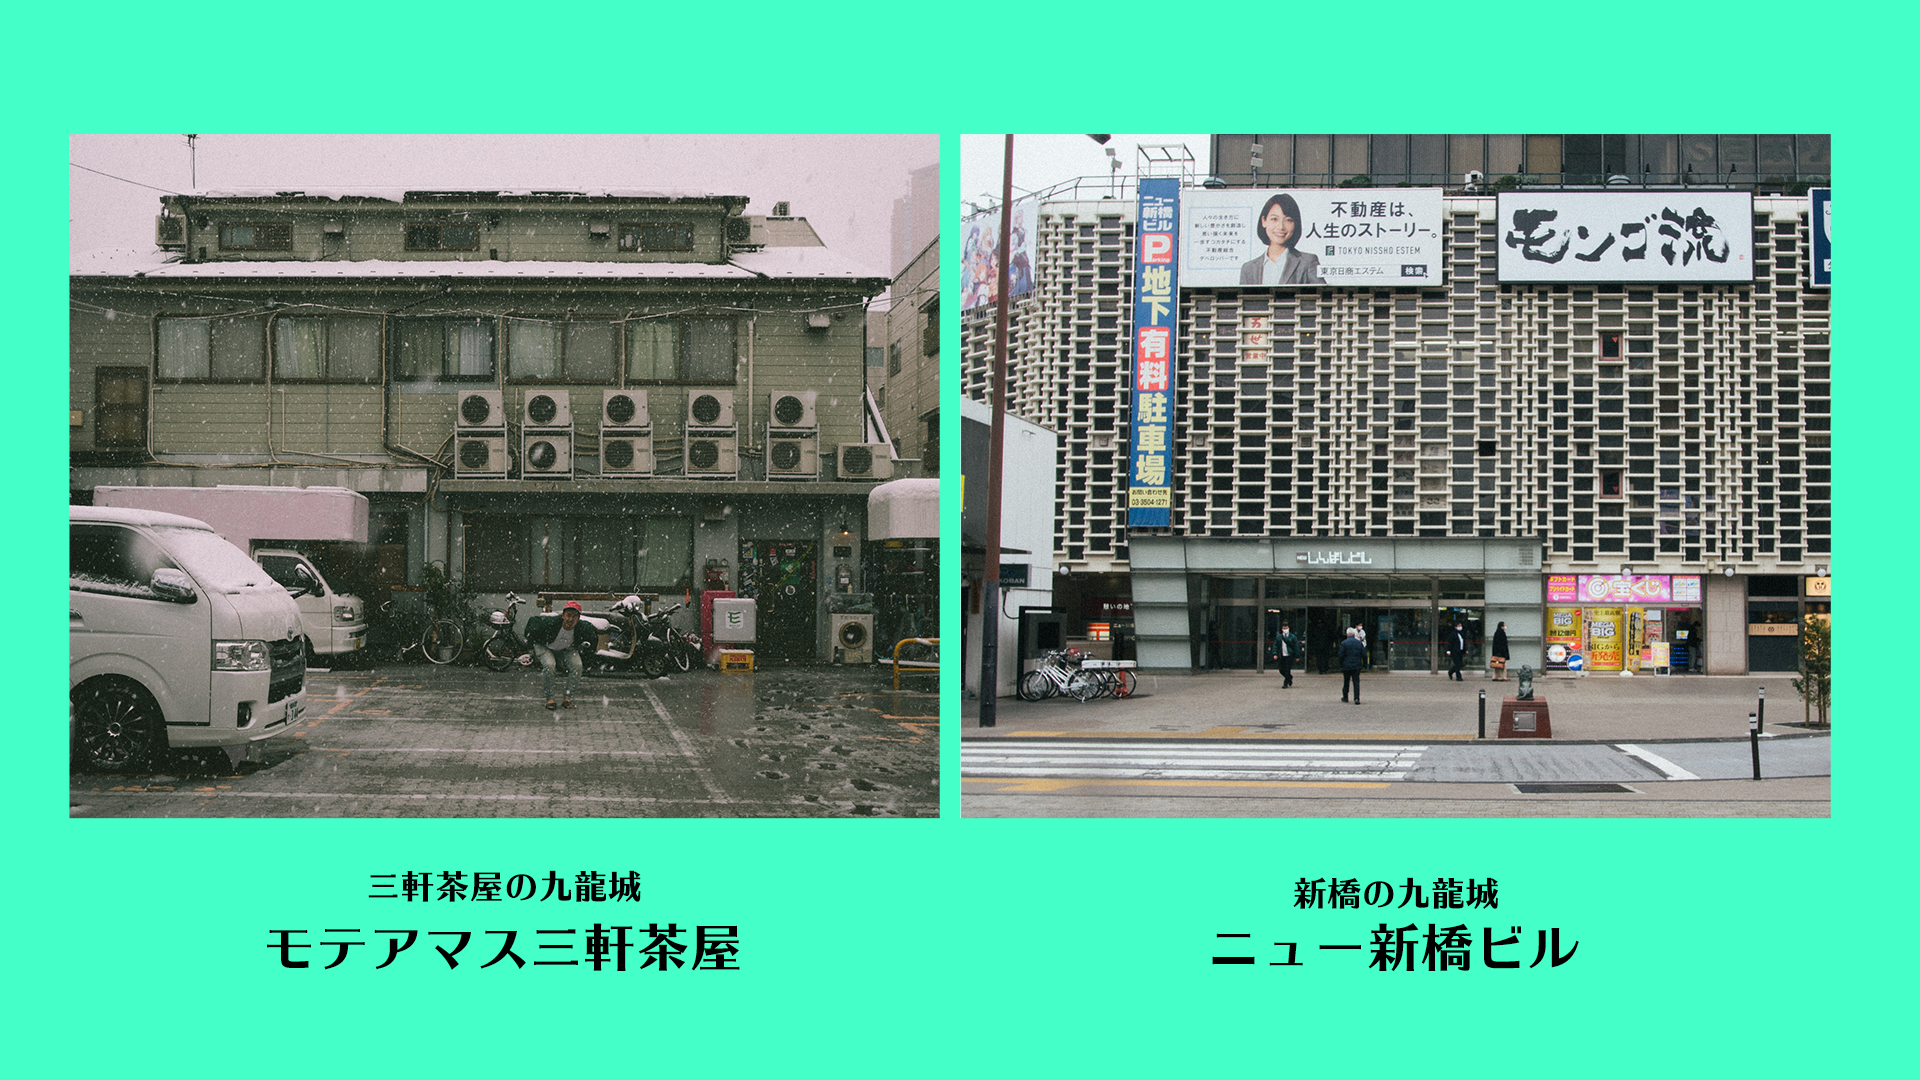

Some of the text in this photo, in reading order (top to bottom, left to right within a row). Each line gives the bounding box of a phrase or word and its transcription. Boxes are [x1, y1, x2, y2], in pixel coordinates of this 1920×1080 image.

[1142, 196, 1173, 206] ニュー
[1142, 207, 1173, 219] 新橋
[1331, 201, 1413, 218] 不動産は、
[1142, 220, 1173, 231] ビル
[1305, 222, 1437, 239] 人生のストーリー。
[1505, 206, 1730, 267] モンゴ流
[1338, 246, 1421, 255] TOKYO NISSHO ESTEM
[1320, 266, 1424, 276] 東京日商エステム 検索
[1613, 580, 1661, 598] 宝くじ
[1103, 602, 1133, 610] 憩いの地
[1553, 617, 1573, 625] BIG
[1591, 627, 1616, 637] BIG
